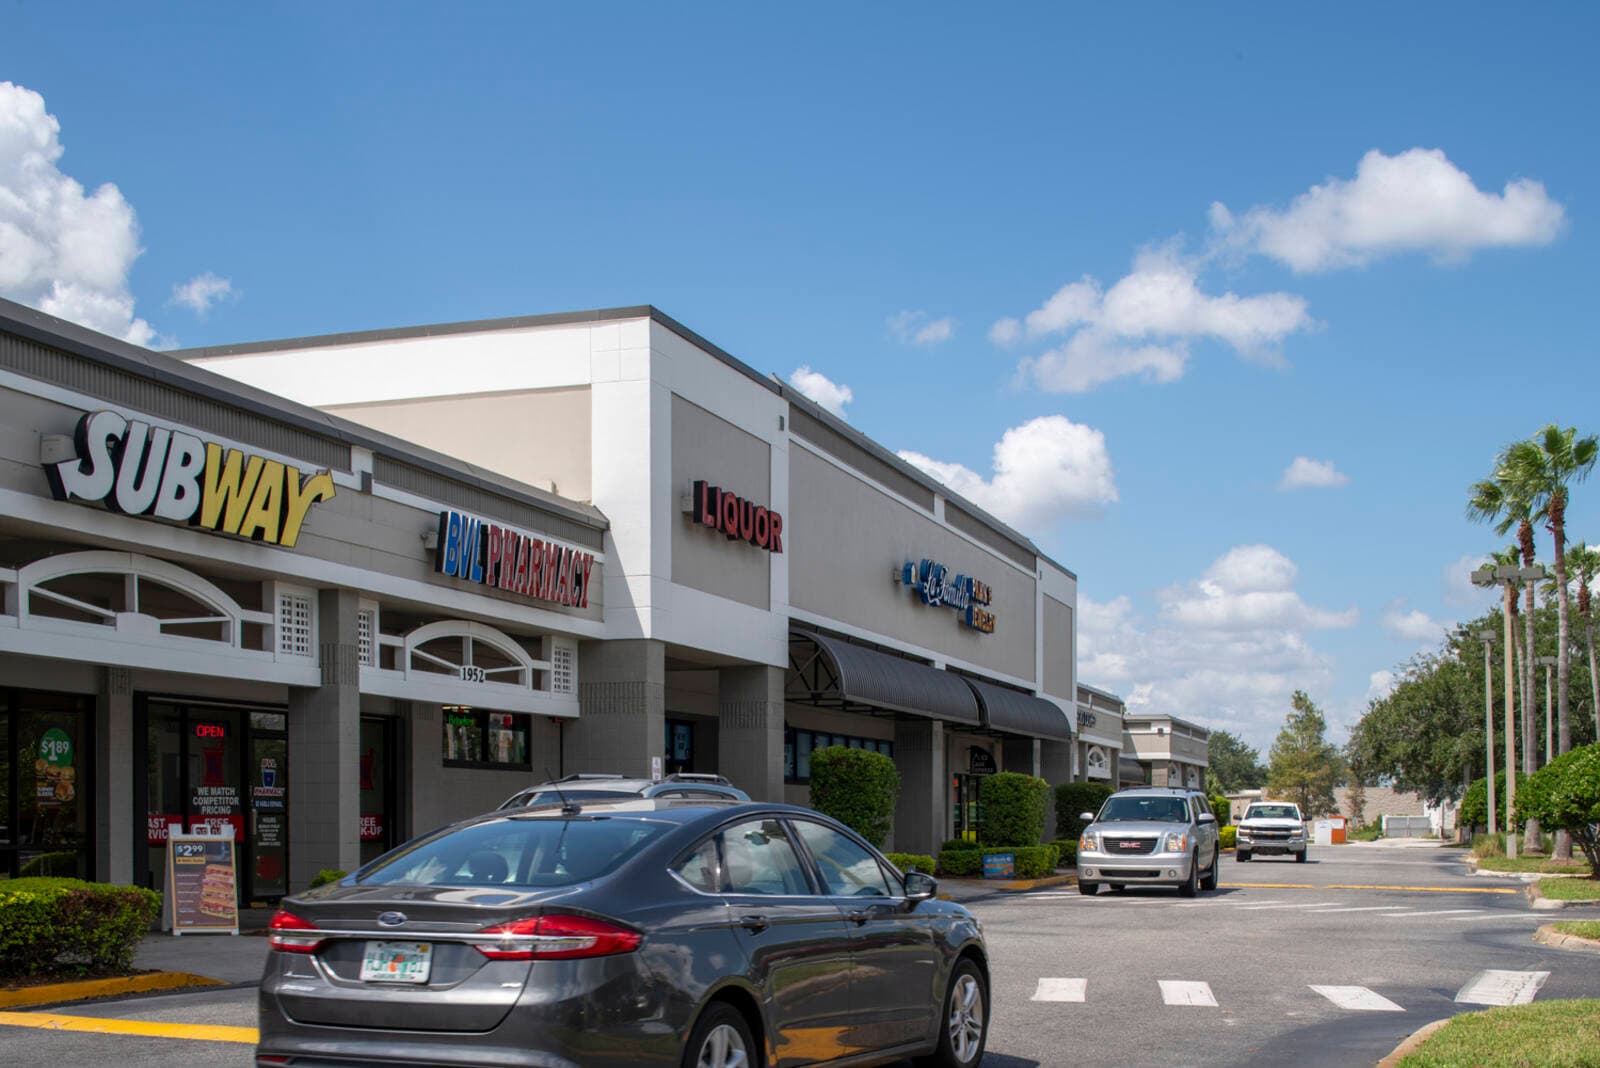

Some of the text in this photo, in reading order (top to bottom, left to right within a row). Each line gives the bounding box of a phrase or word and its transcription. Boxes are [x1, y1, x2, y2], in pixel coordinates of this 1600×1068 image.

[57, 410, 337, 548] SUBWAY
[702, 480, 783, 554] LIQUOR
[442, 511, 595, 609] BVL PHARMACY
[462, 667, 485, 683] 1952
[196, 724, 225, 737] OPEN
[197, 786, 236, 796] WE MATCH
[192, 796, 240, 806] COMPETITOR
[201, 806, 232, 815] PRICING
[148, 818, 166, 828] AST
[360, 817, 376, 826] REE
[148, 829, 168, 839] RVIC
[360, 826, 383, 836] K-UP
